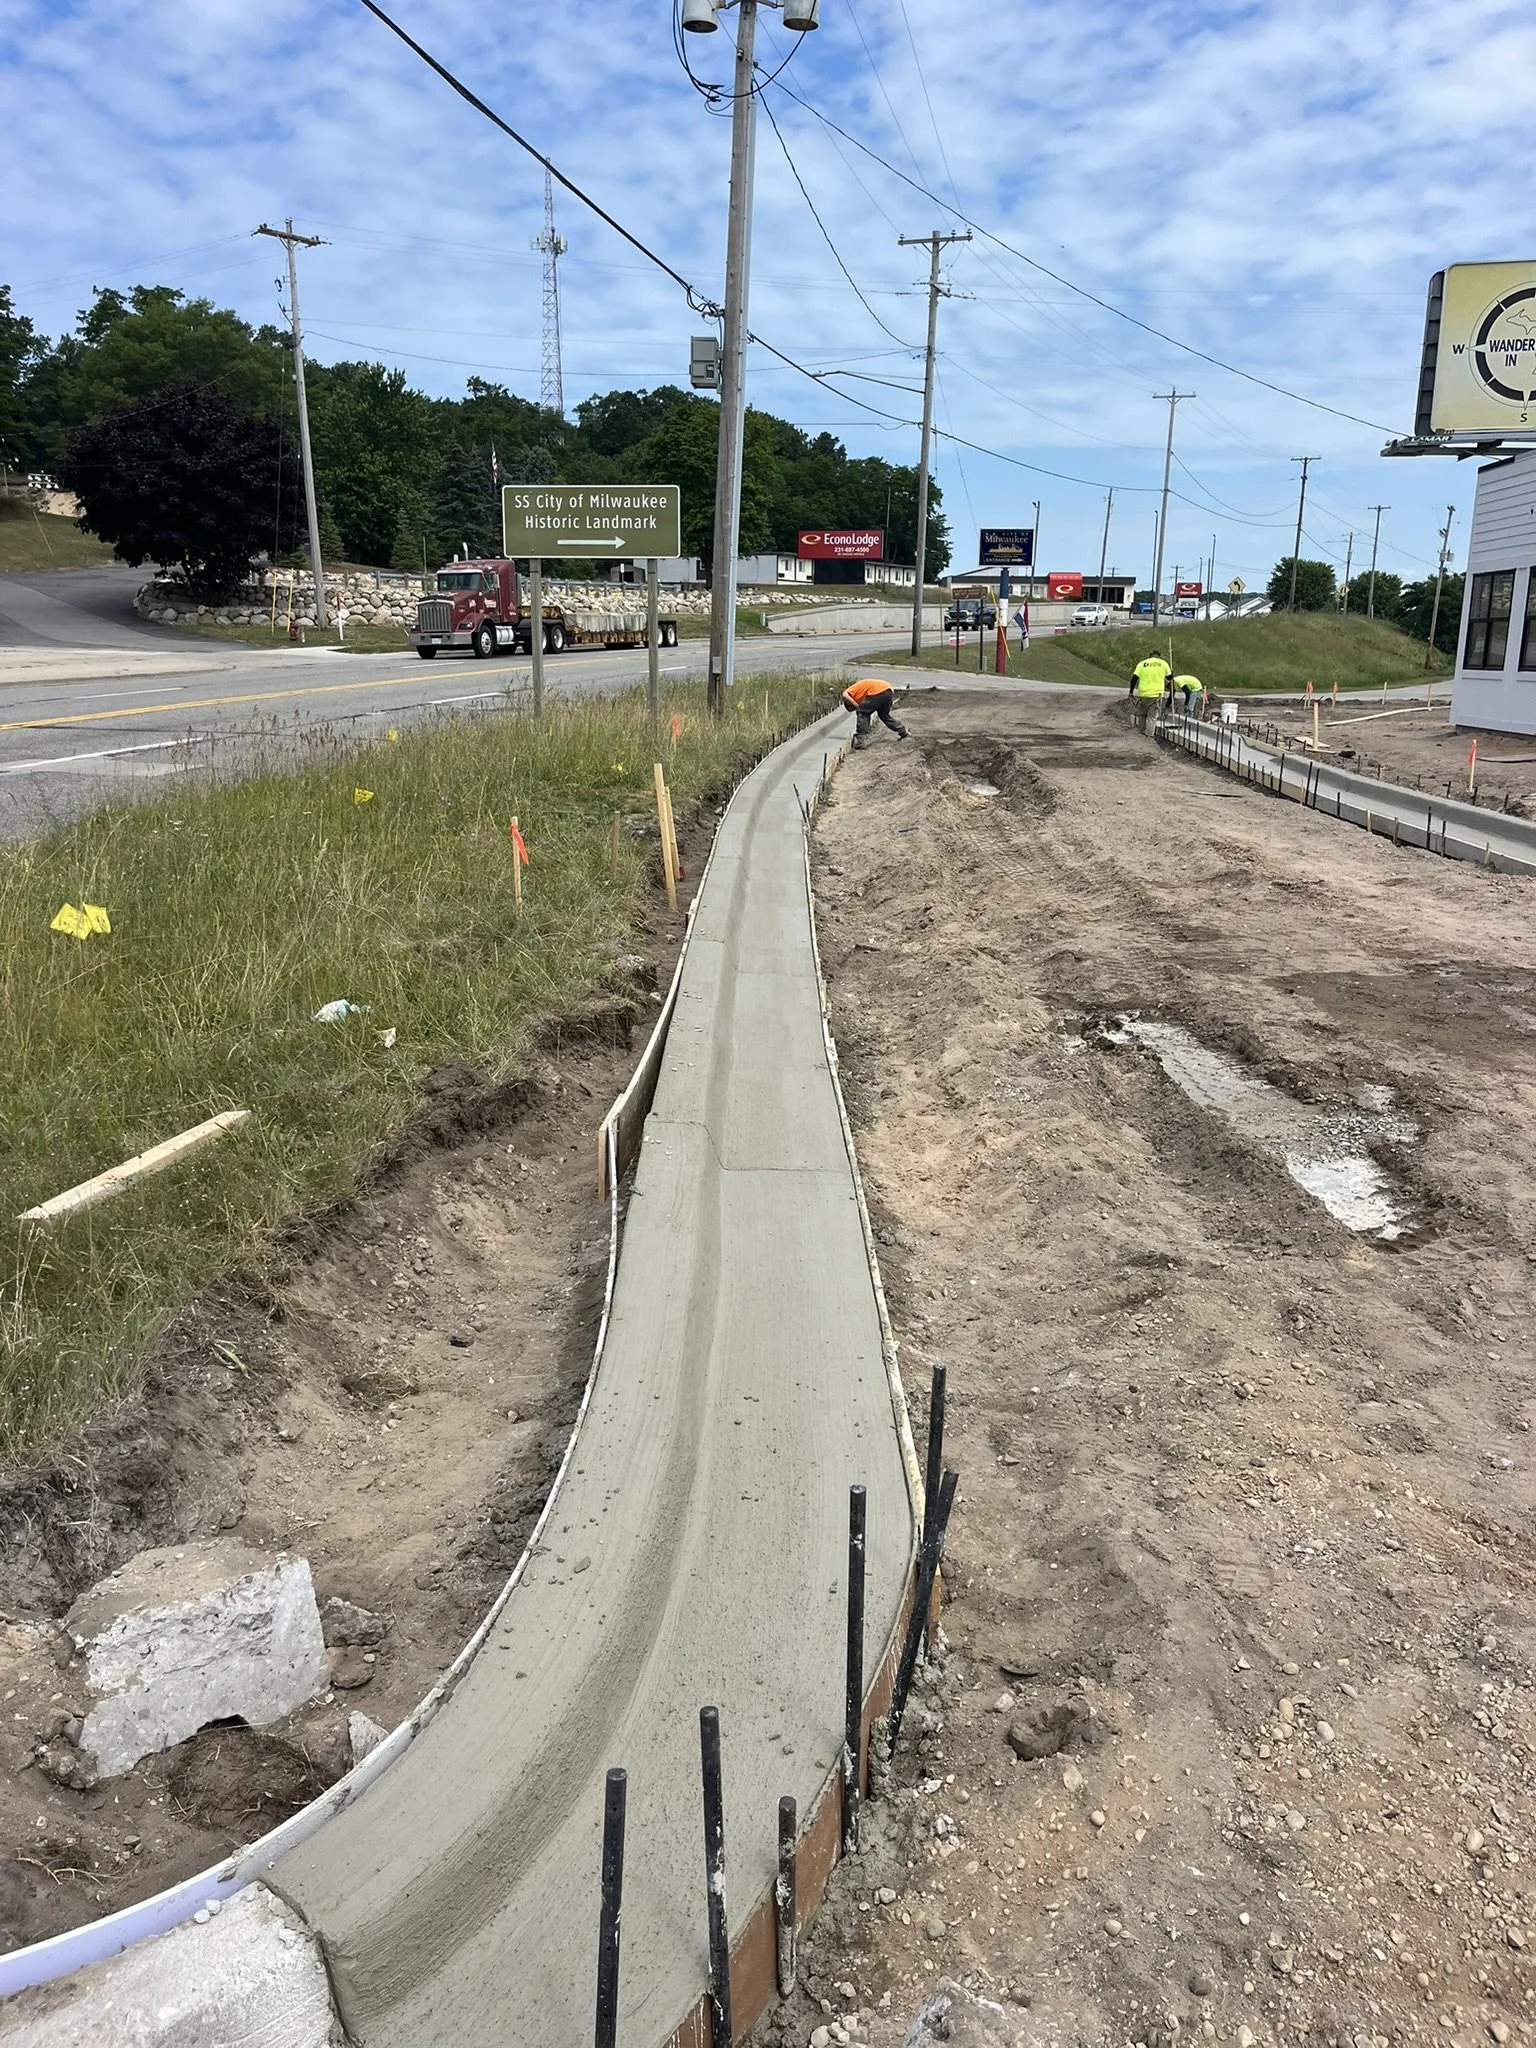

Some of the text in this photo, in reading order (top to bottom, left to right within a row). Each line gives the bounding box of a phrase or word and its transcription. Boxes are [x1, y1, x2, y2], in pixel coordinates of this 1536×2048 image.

[1452, 343, 1465, 355] W
[1489, 338, 1535, 353] WANDER
[1504, 354, 1518, 367] IN
[1519, 412, 1528, 423] S
[514, 493, 667, 512] SS City of Milwaukee
[525, 514, 657, 529] Historic Landmark
[824, 533, 880, 547] EconoLodge
